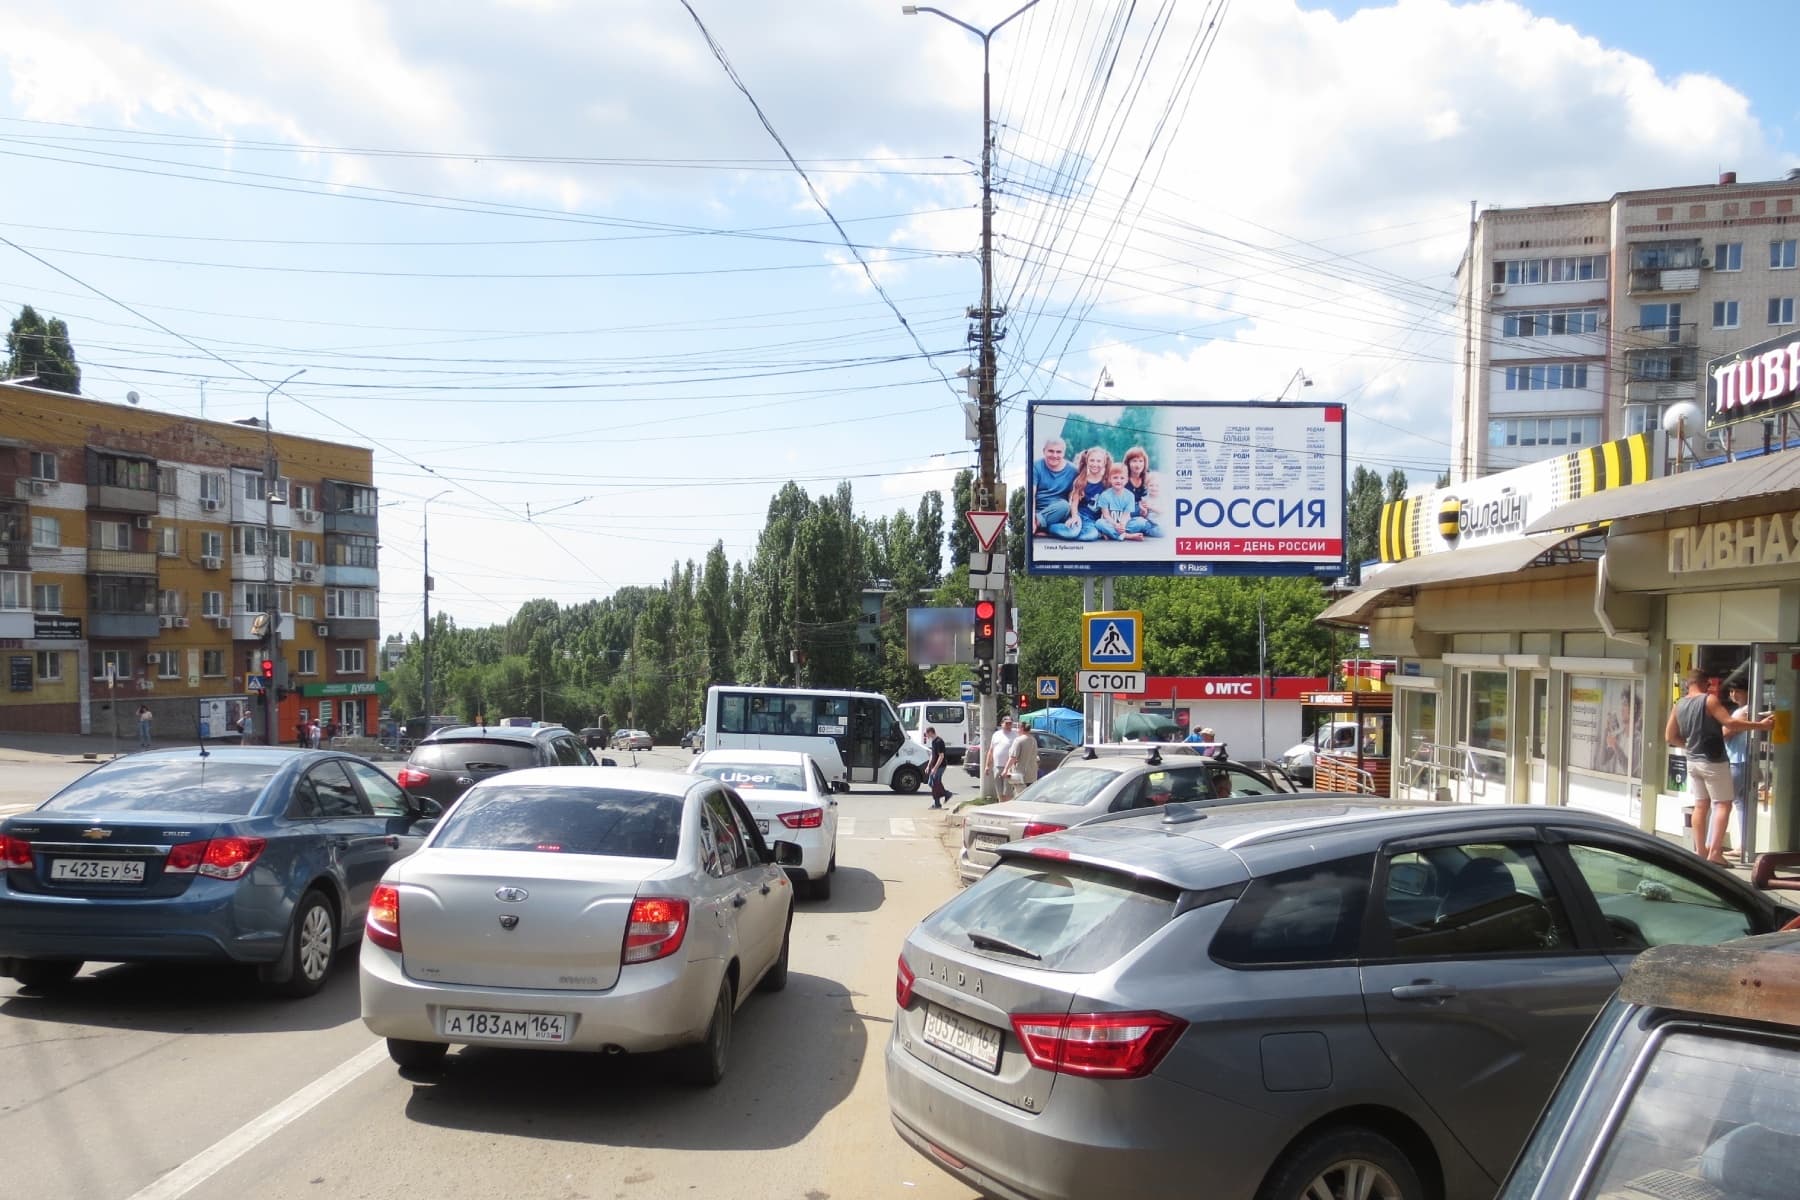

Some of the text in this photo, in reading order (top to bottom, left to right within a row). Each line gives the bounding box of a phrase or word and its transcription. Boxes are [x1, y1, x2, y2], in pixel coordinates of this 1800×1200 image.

[1175, 498, 1326, 528] РОССИЯ
[1459, 487, 1521, 531] билайн
[1179, 541, 1192, 550] 12
[1195, 541, 1230, 551] ИЮНЯ
[1243, 541, 1275, 552] ДЕНЬ
[1278, 541, 1326, 551] РОССИИ
[983, 624, 992, 636] 6
[1088, 675, 1136, 689] СТОП
[1215, 682, 1252, 694] МТС
[720, 772, 773, 783] Uber
[59, 862, 140, 879] Т423ЕУ 64
[929, 959, 984, 994] LADA
[450, 1013, 560, 1037] А183АМ 164
